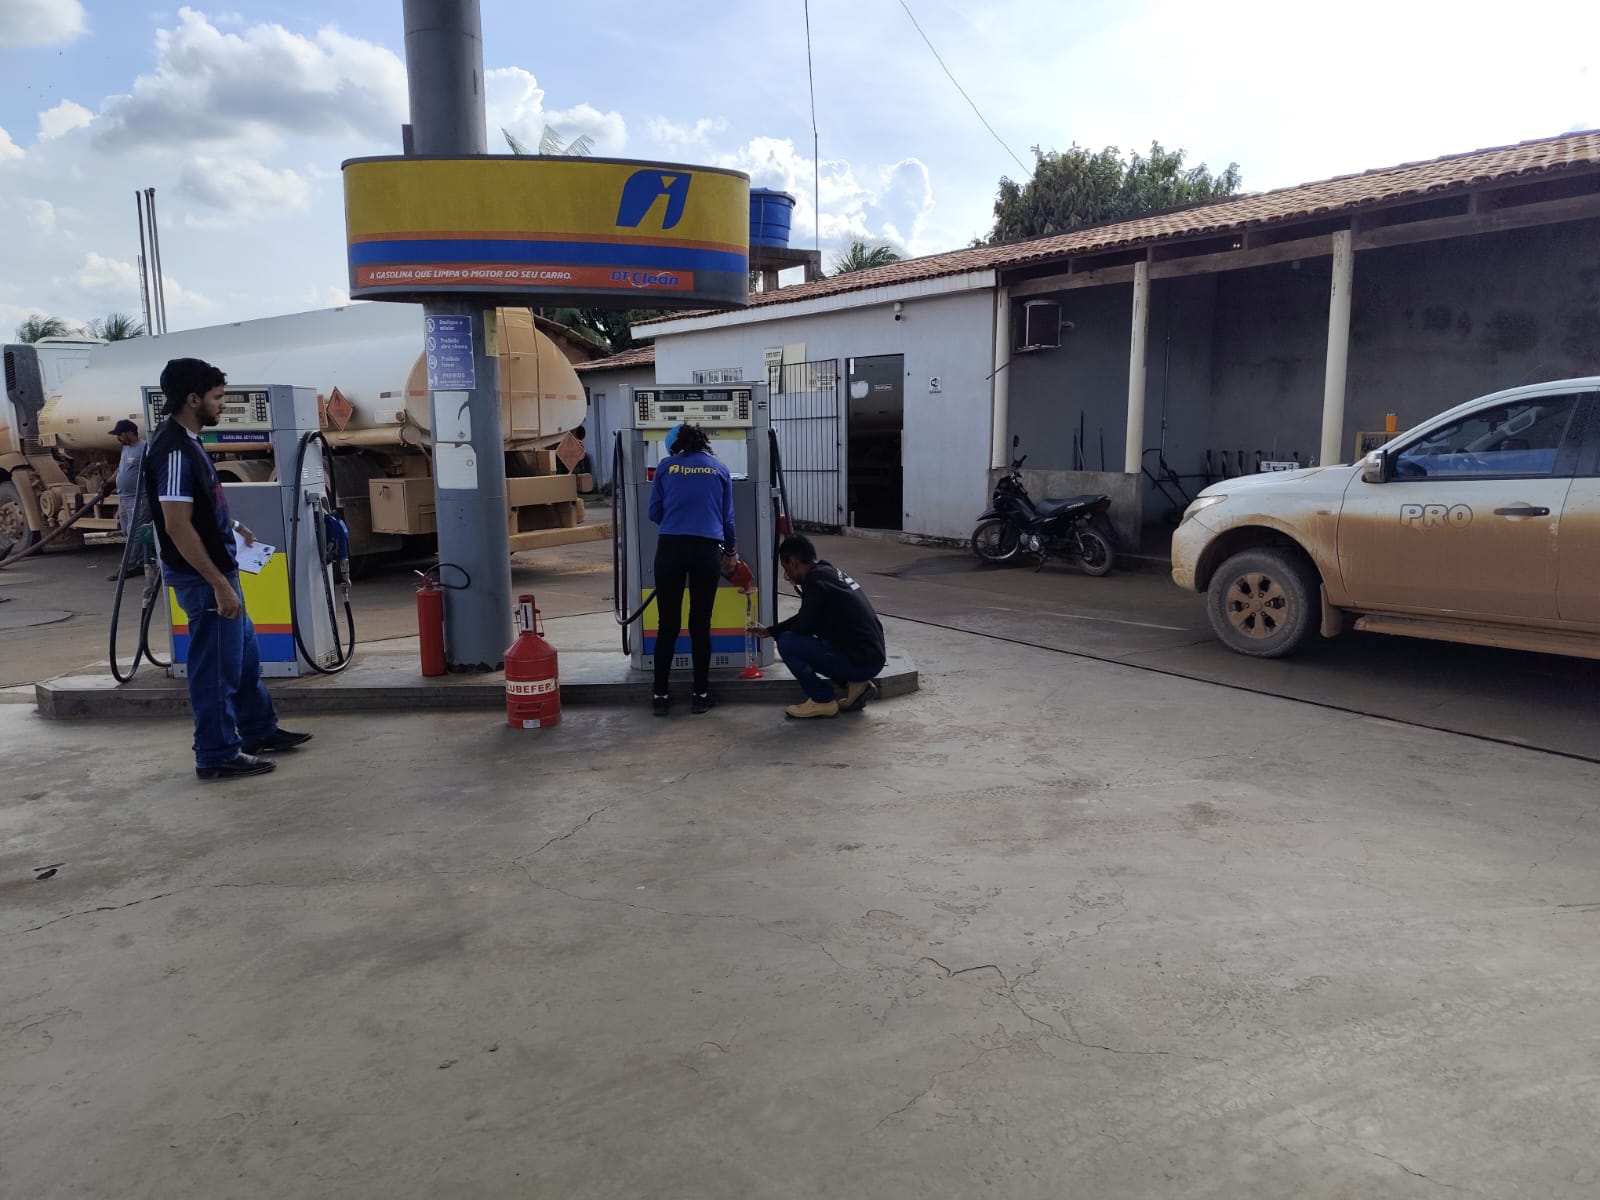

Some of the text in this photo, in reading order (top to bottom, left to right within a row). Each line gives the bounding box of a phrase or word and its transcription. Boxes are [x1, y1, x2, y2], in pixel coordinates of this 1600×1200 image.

[376, 271, 412, 279] GASOLINA
[414, 270, 432, 279] QUE
[433, 270, 460, 278] LIMPA
[461, 270, 469, 278] O
[470, 270, 503, 278] MOTOR
[504, 270, 519, 278] DO
[520, 271, 538, 279] SEU
[540, 271, 573, 280] CARRO.
[631, 271, 679, 286] Clean
[1399, 503, 1474, 529] PRO
